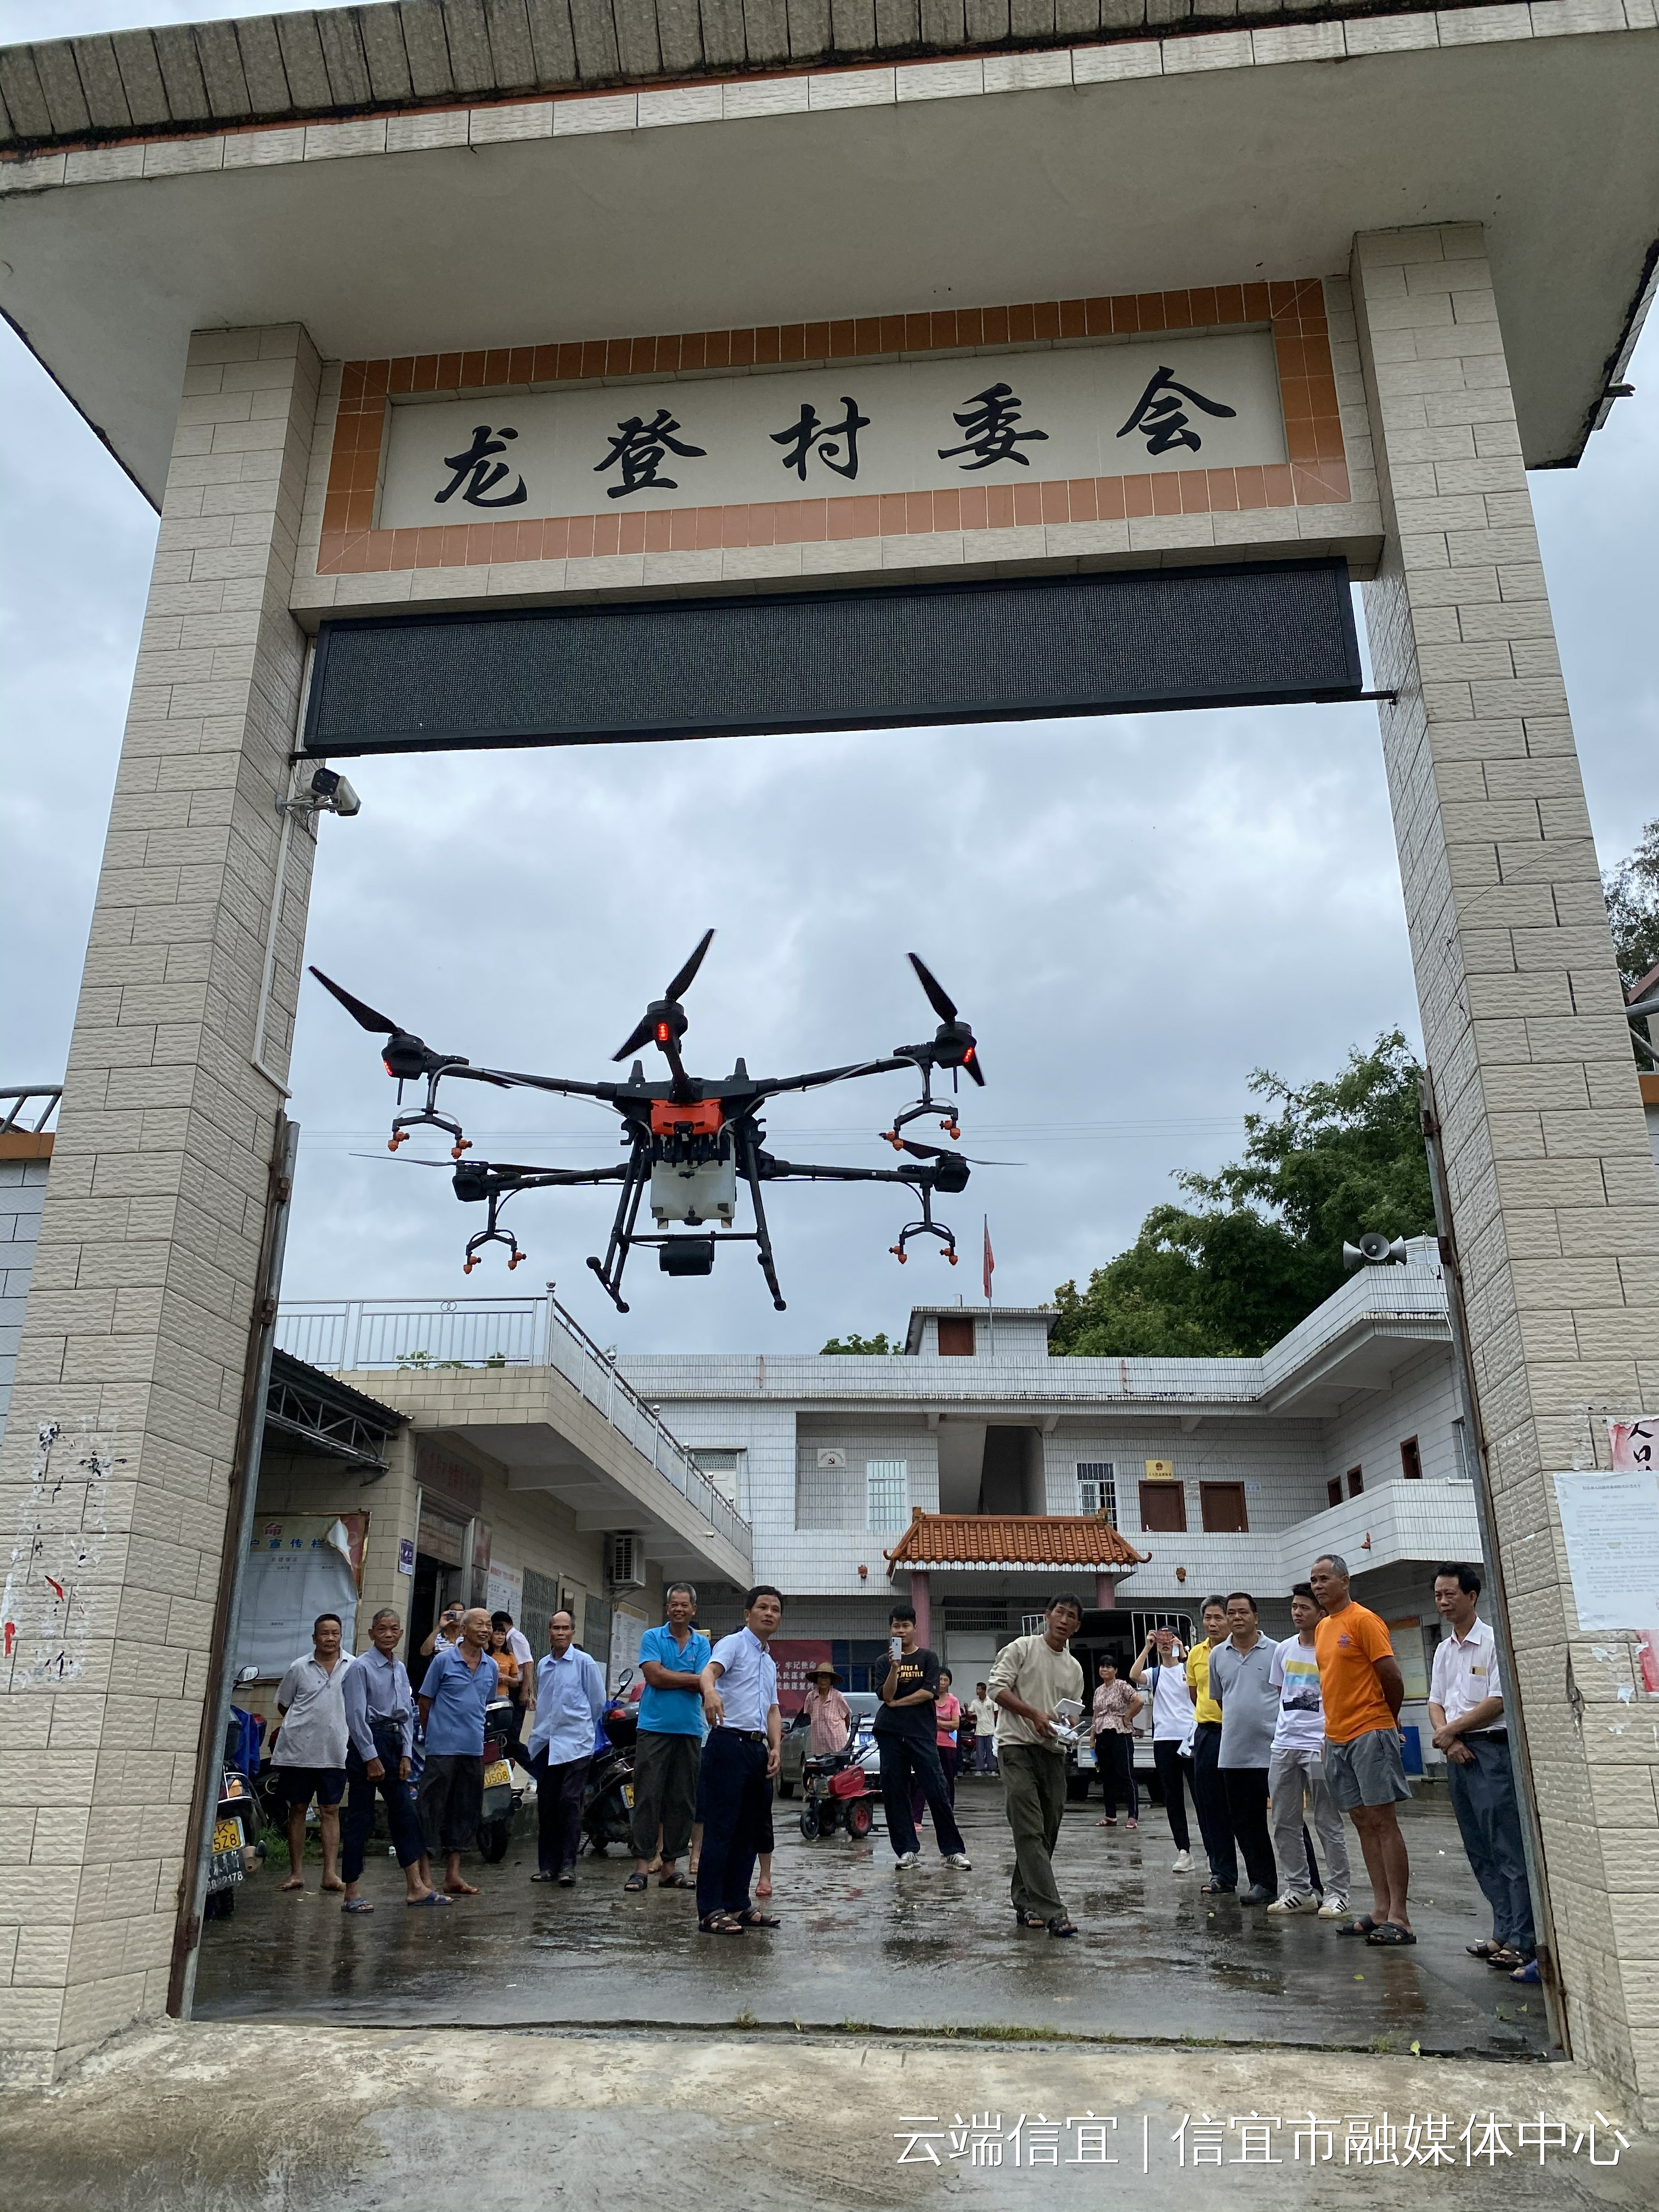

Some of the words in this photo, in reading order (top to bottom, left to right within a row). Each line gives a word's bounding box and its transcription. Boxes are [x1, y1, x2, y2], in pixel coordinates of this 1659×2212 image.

[435, 366, 1237, 507] 龙登村委会
